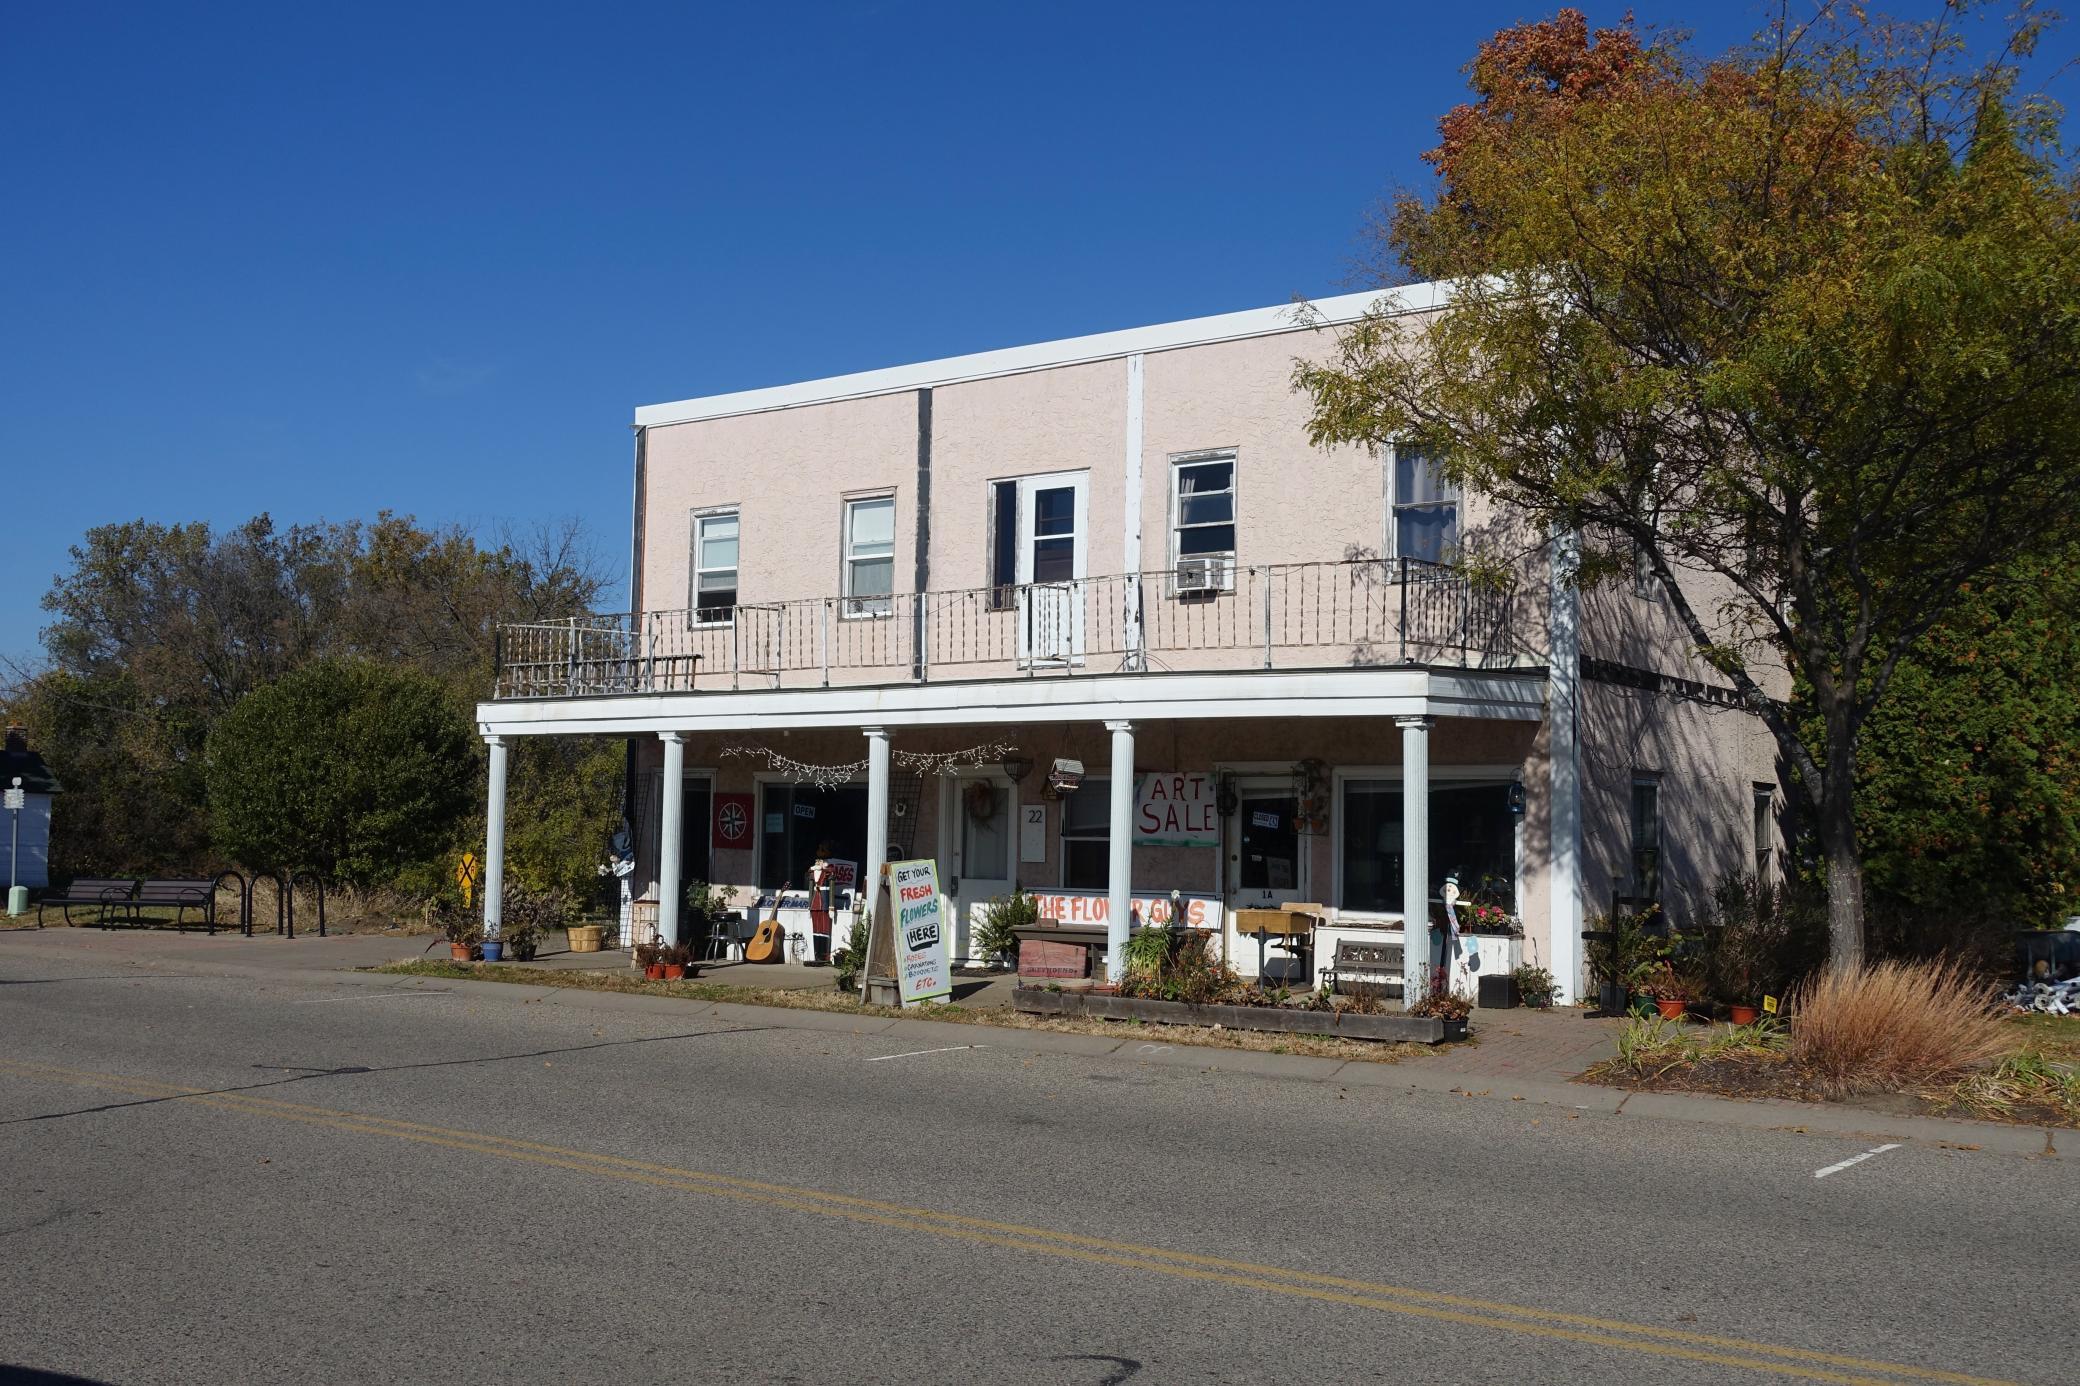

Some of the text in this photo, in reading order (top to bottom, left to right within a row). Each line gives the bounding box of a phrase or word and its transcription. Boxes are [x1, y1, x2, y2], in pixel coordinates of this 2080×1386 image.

[1151, 776, 1205, 801] ART
[795, 806, 815, 817] OPEN
[1028, 809, 1043, 824] 22
[1139, 803, 1215, 834] SALE
[898, 866, 931, 882] GET YOUR
[900, 884, 933, 902] FRESH
[1262, 890, 1273, 899] 1A
[790, 899, 809, 908] MAR
[1035, 894, 1206, 925] THE FLOR GUYS
[900, 898, 938, 928] FLOWERS
[909, 925, 937, 943] HERE
[916, 977, 937, 991] ETC.
